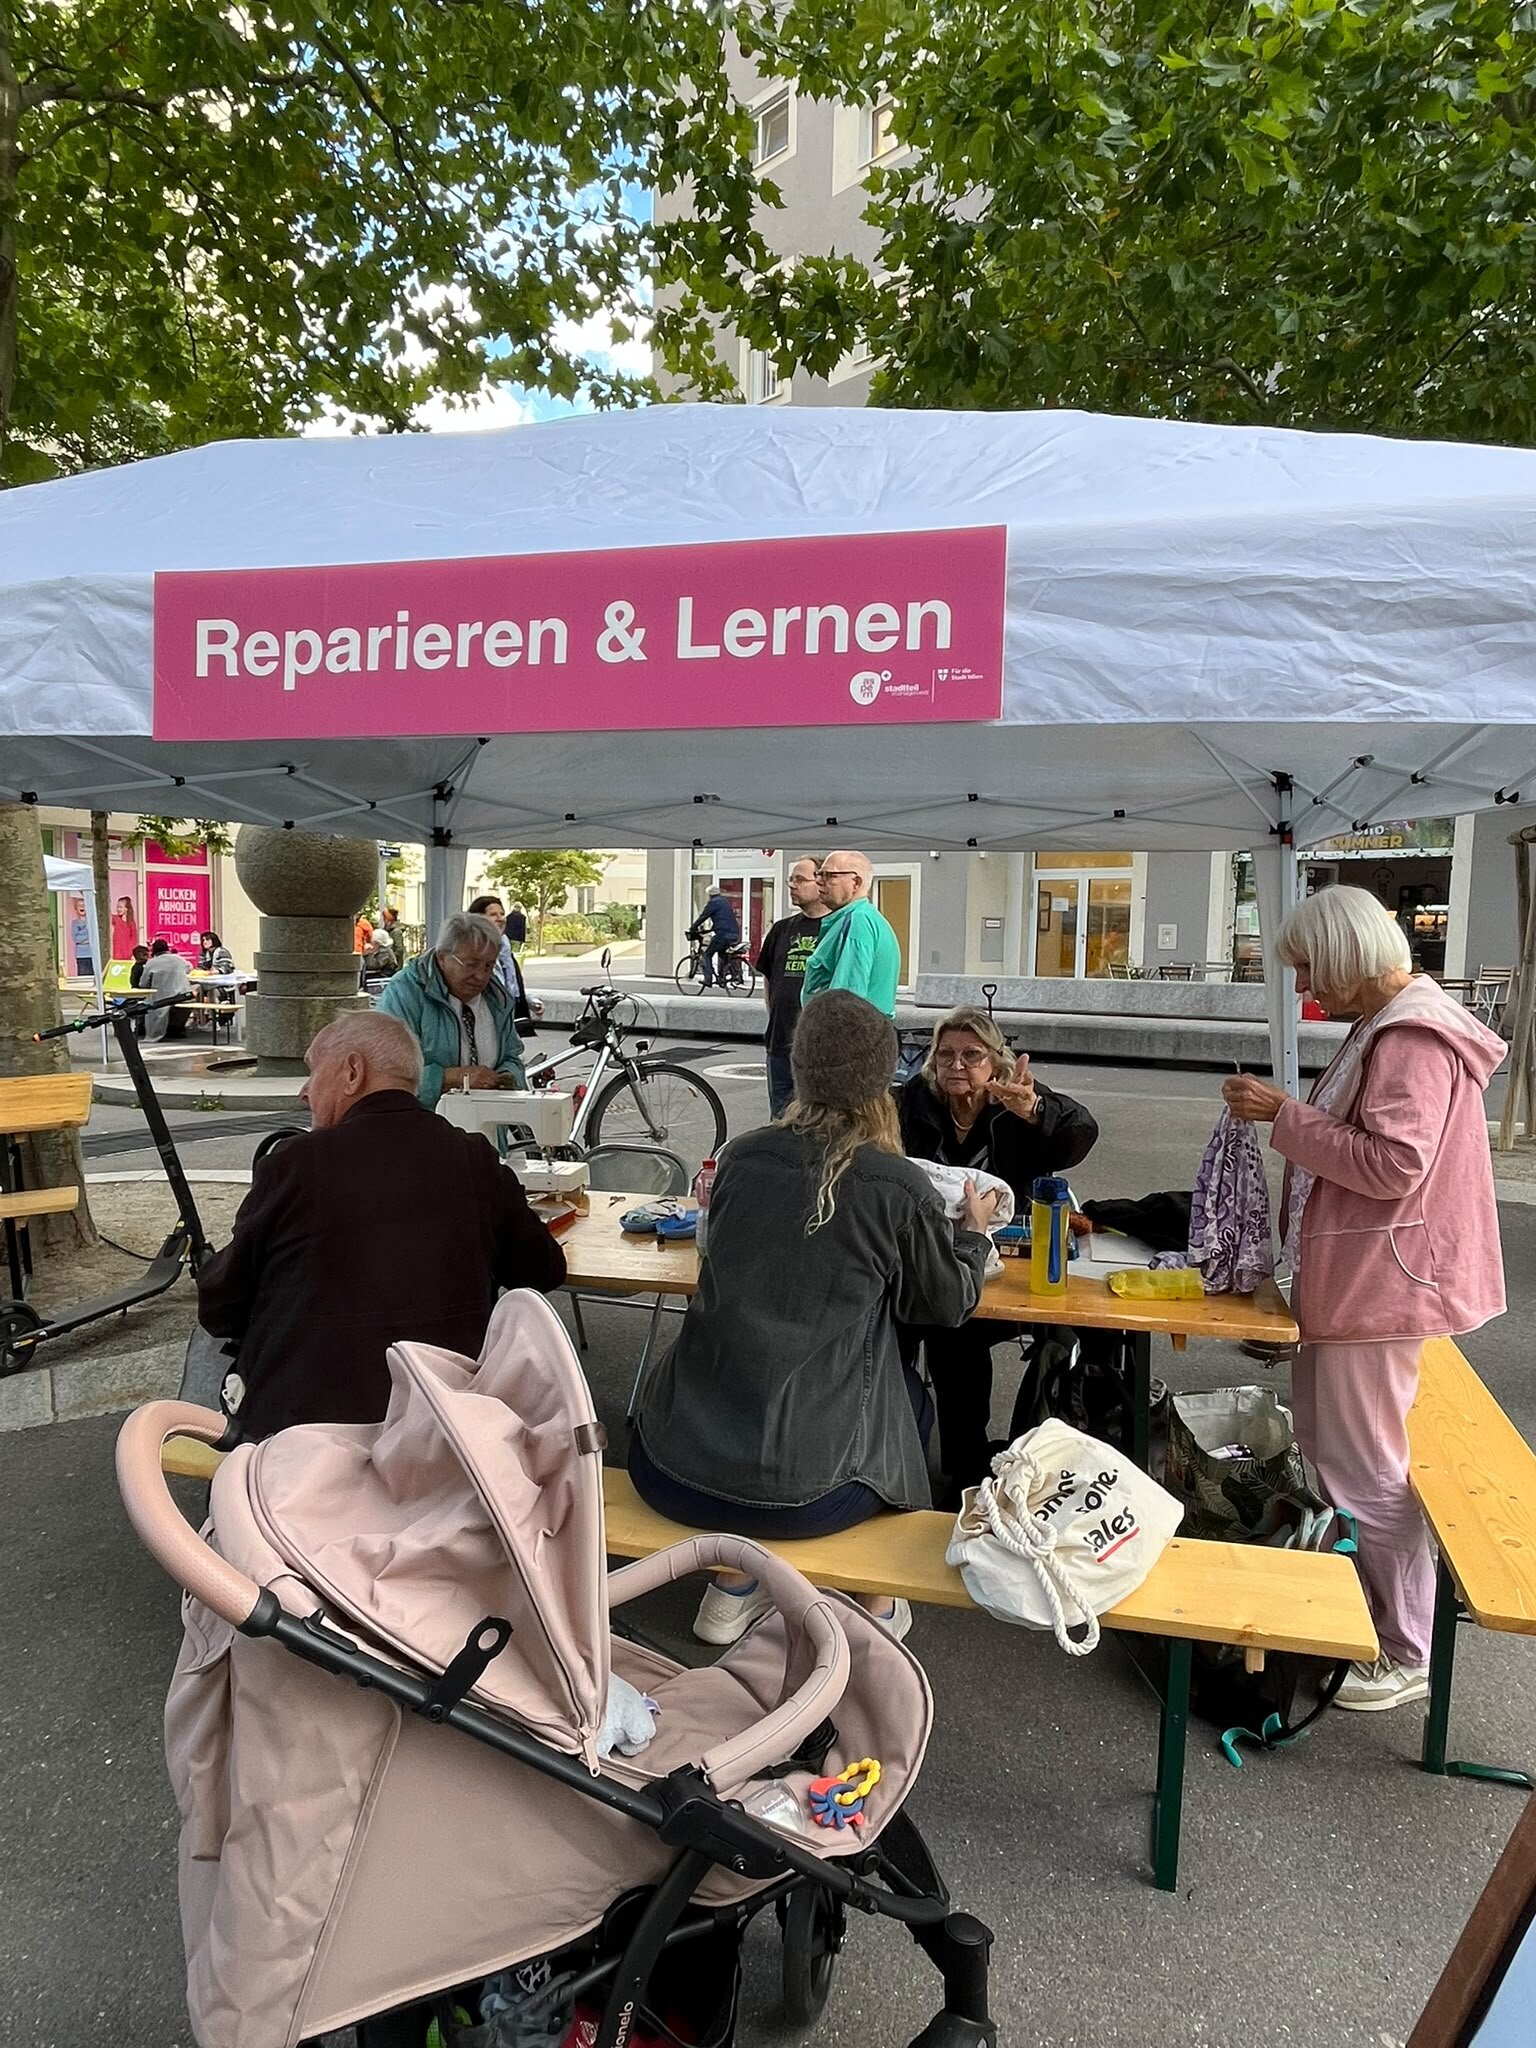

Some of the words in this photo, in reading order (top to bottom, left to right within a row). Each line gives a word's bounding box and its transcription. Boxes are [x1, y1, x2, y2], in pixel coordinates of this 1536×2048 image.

[196, 610, 569, 691] Reparieren
[596, 600, 648, 663] &
[677, 596, 951, 659] Lernen
[157, 887, 197, 900] KLICKEN
[157, 900, 197, 913] ABHOLEN
[158, 913, 197, 926] FREUEN
